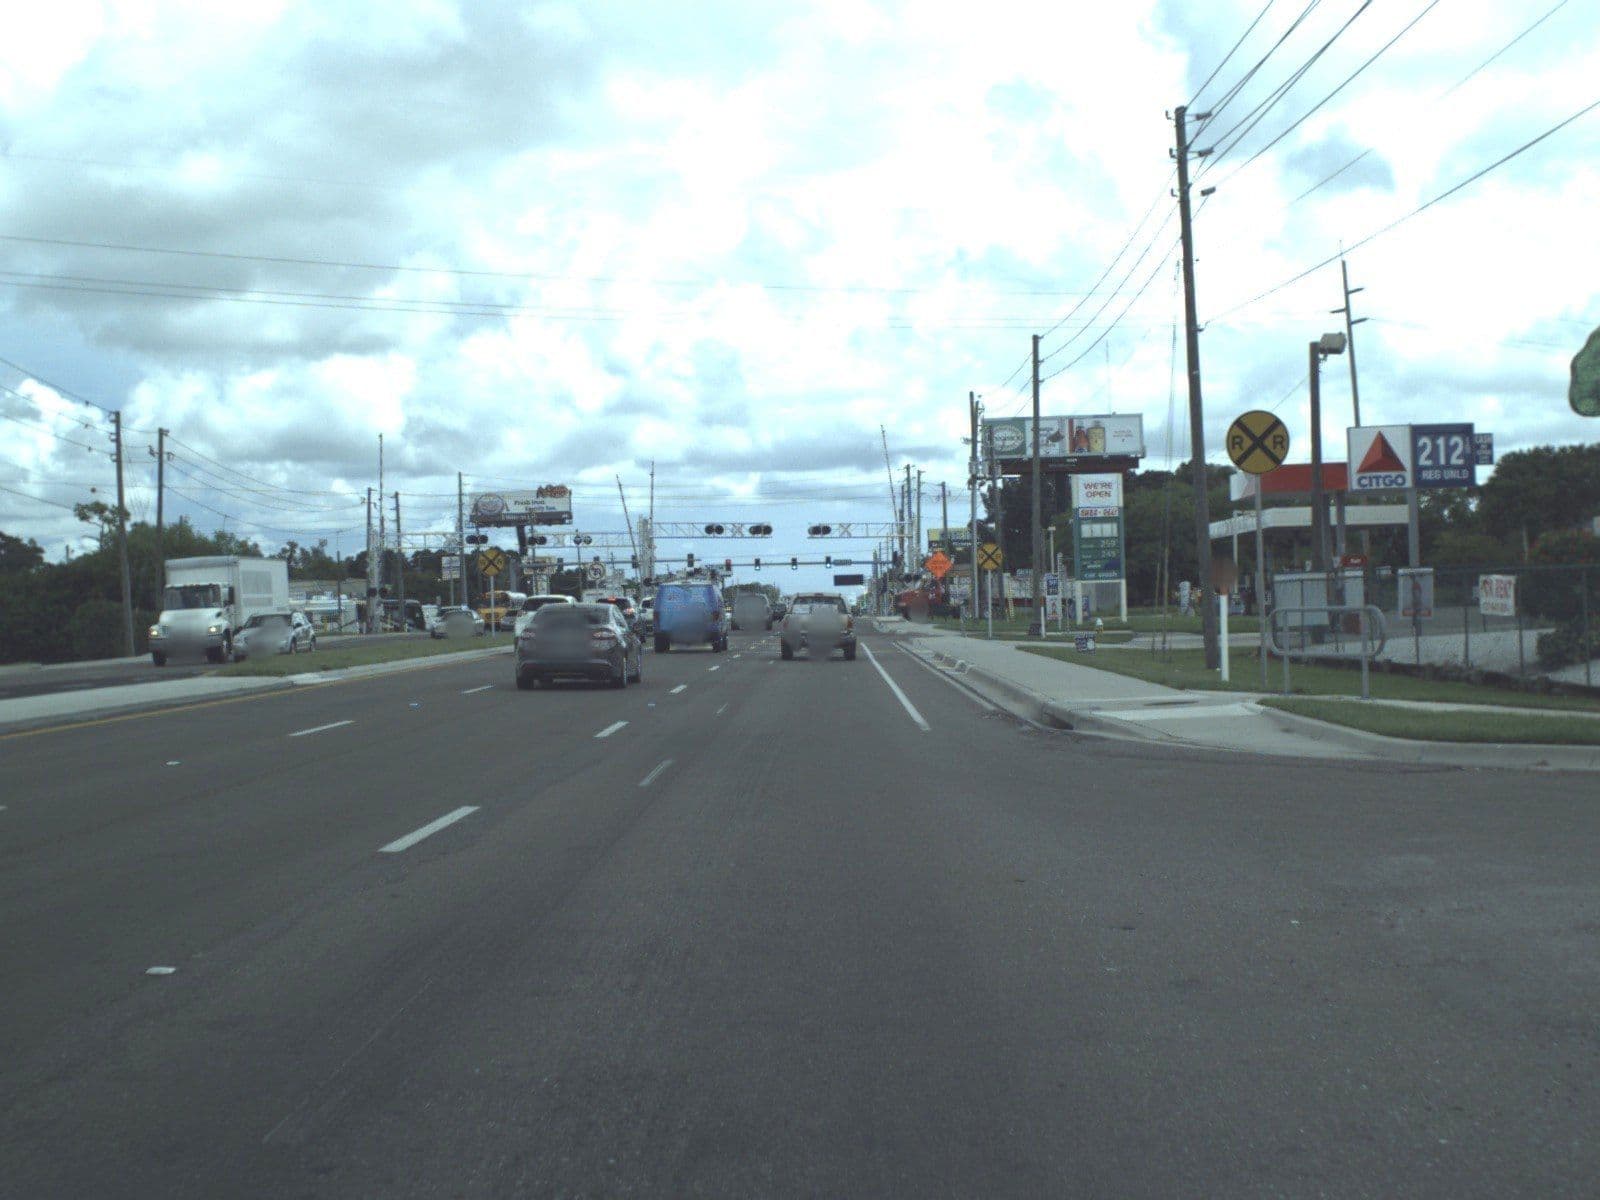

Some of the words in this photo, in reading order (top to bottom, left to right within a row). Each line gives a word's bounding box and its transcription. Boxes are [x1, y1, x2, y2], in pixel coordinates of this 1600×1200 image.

[1231, 435, 1244, 451] R
[1272, 434, 1286, 450] R
[1417, 436, 1464, 466] 212
[1357, 474, 1406, 488] CITGO
[1422, 469, 1441, 480] REG
[1443, 469, 1469, 480] UNLD
[1086, 490, 1112, 498] OPEN
